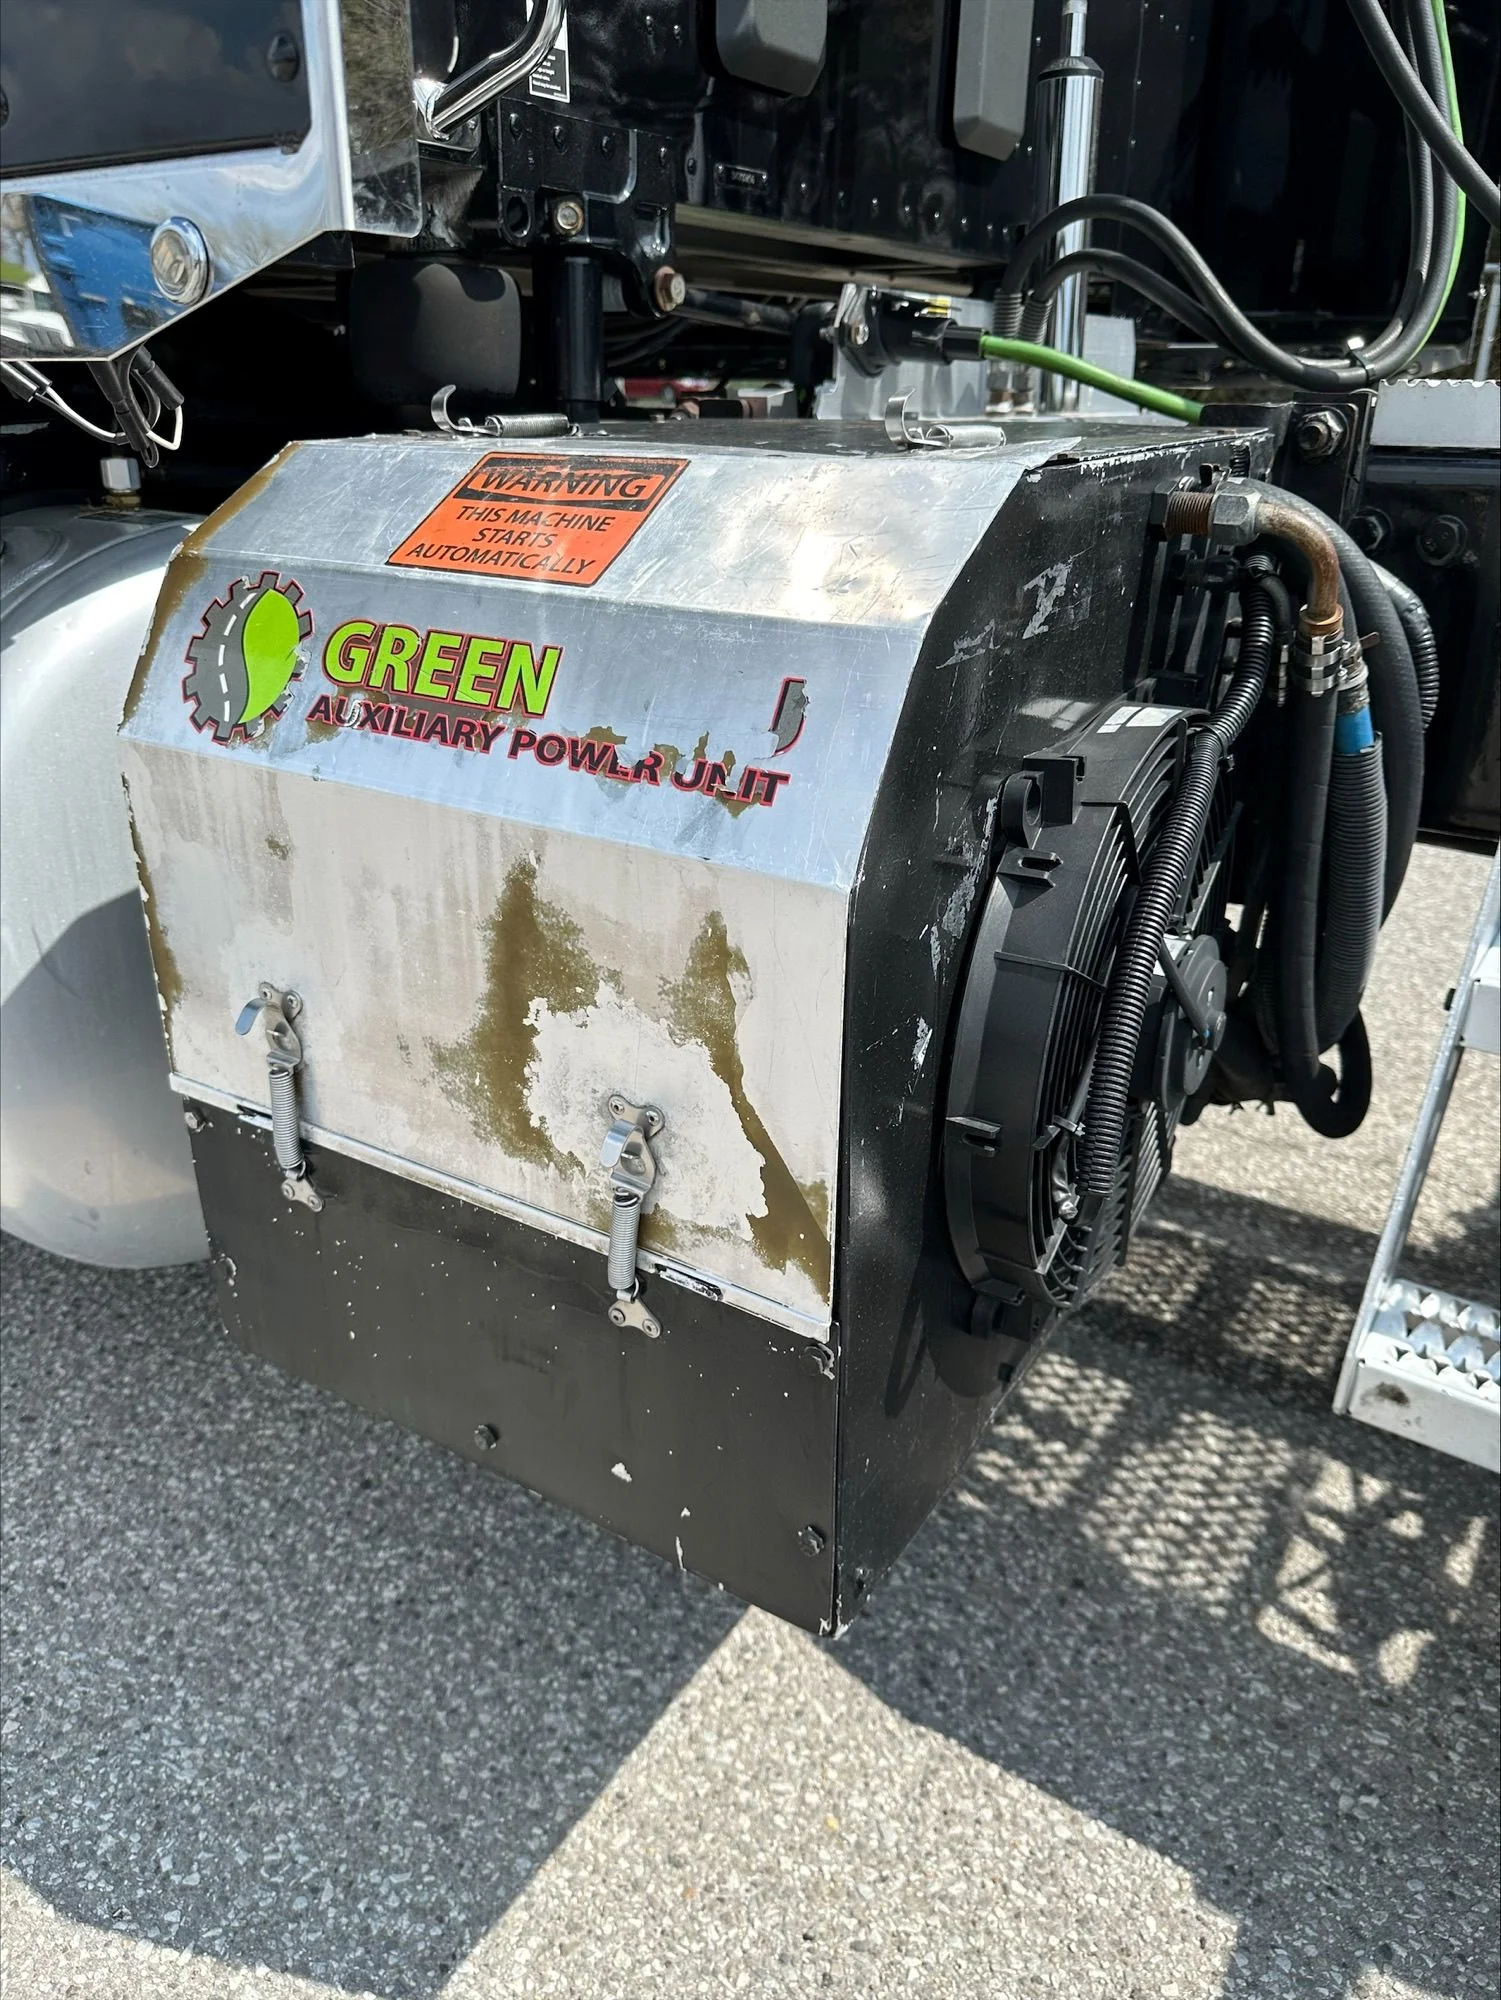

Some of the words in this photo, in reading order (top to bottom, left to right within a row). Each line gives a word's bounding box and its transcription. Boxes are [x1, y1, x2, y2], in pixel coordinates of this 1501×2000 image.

[481, 470, 650, 497] WARNING
[456, 505, 508, 523] THIS
[507, 509, 615, 532] MACHINE
[473, 528, 558, 548] STARTS
[405, 543, 596, 575] AUTOMATICALLY
[321, 619, 564, 718] GREEN
[306, 694, 507, 754] AUXILIARY
